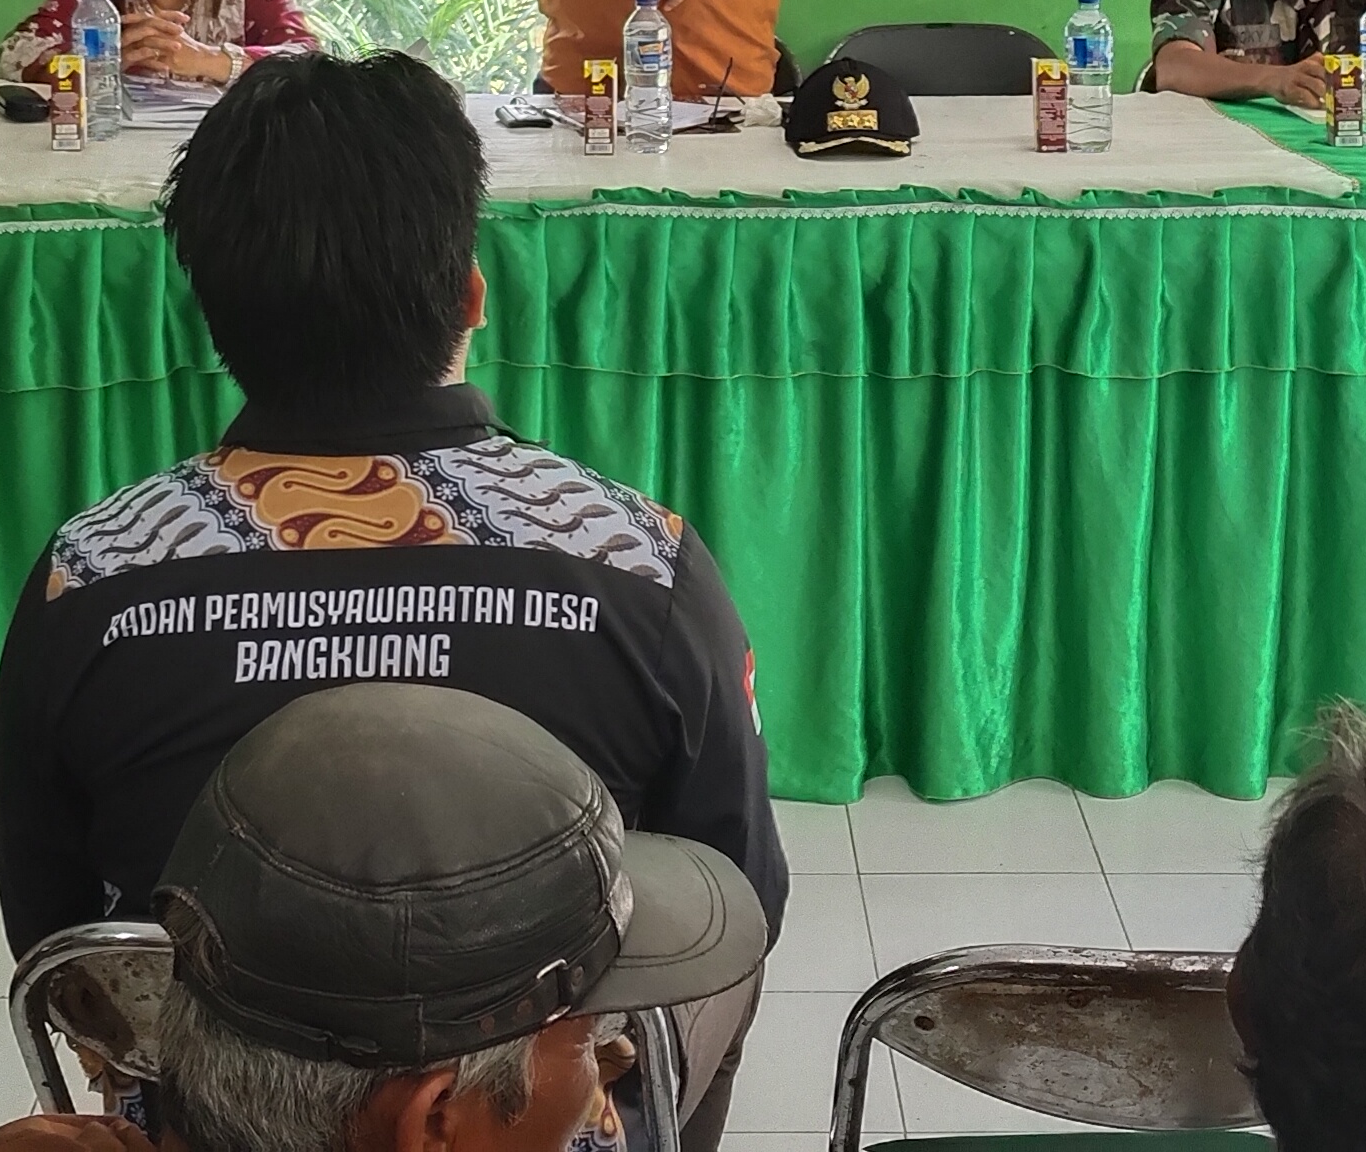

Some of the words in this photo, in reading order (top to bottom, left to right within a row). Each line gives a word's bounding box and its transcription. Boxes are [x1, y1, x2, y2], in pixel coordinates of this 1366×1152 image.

[103, 595, 196, 647] BADAN
[204, 585, 515, 632] PERMUSYAWARATAN
[524, 588, 600, 633] DESA
[235, 633, 451, 684] BANGKUANG
